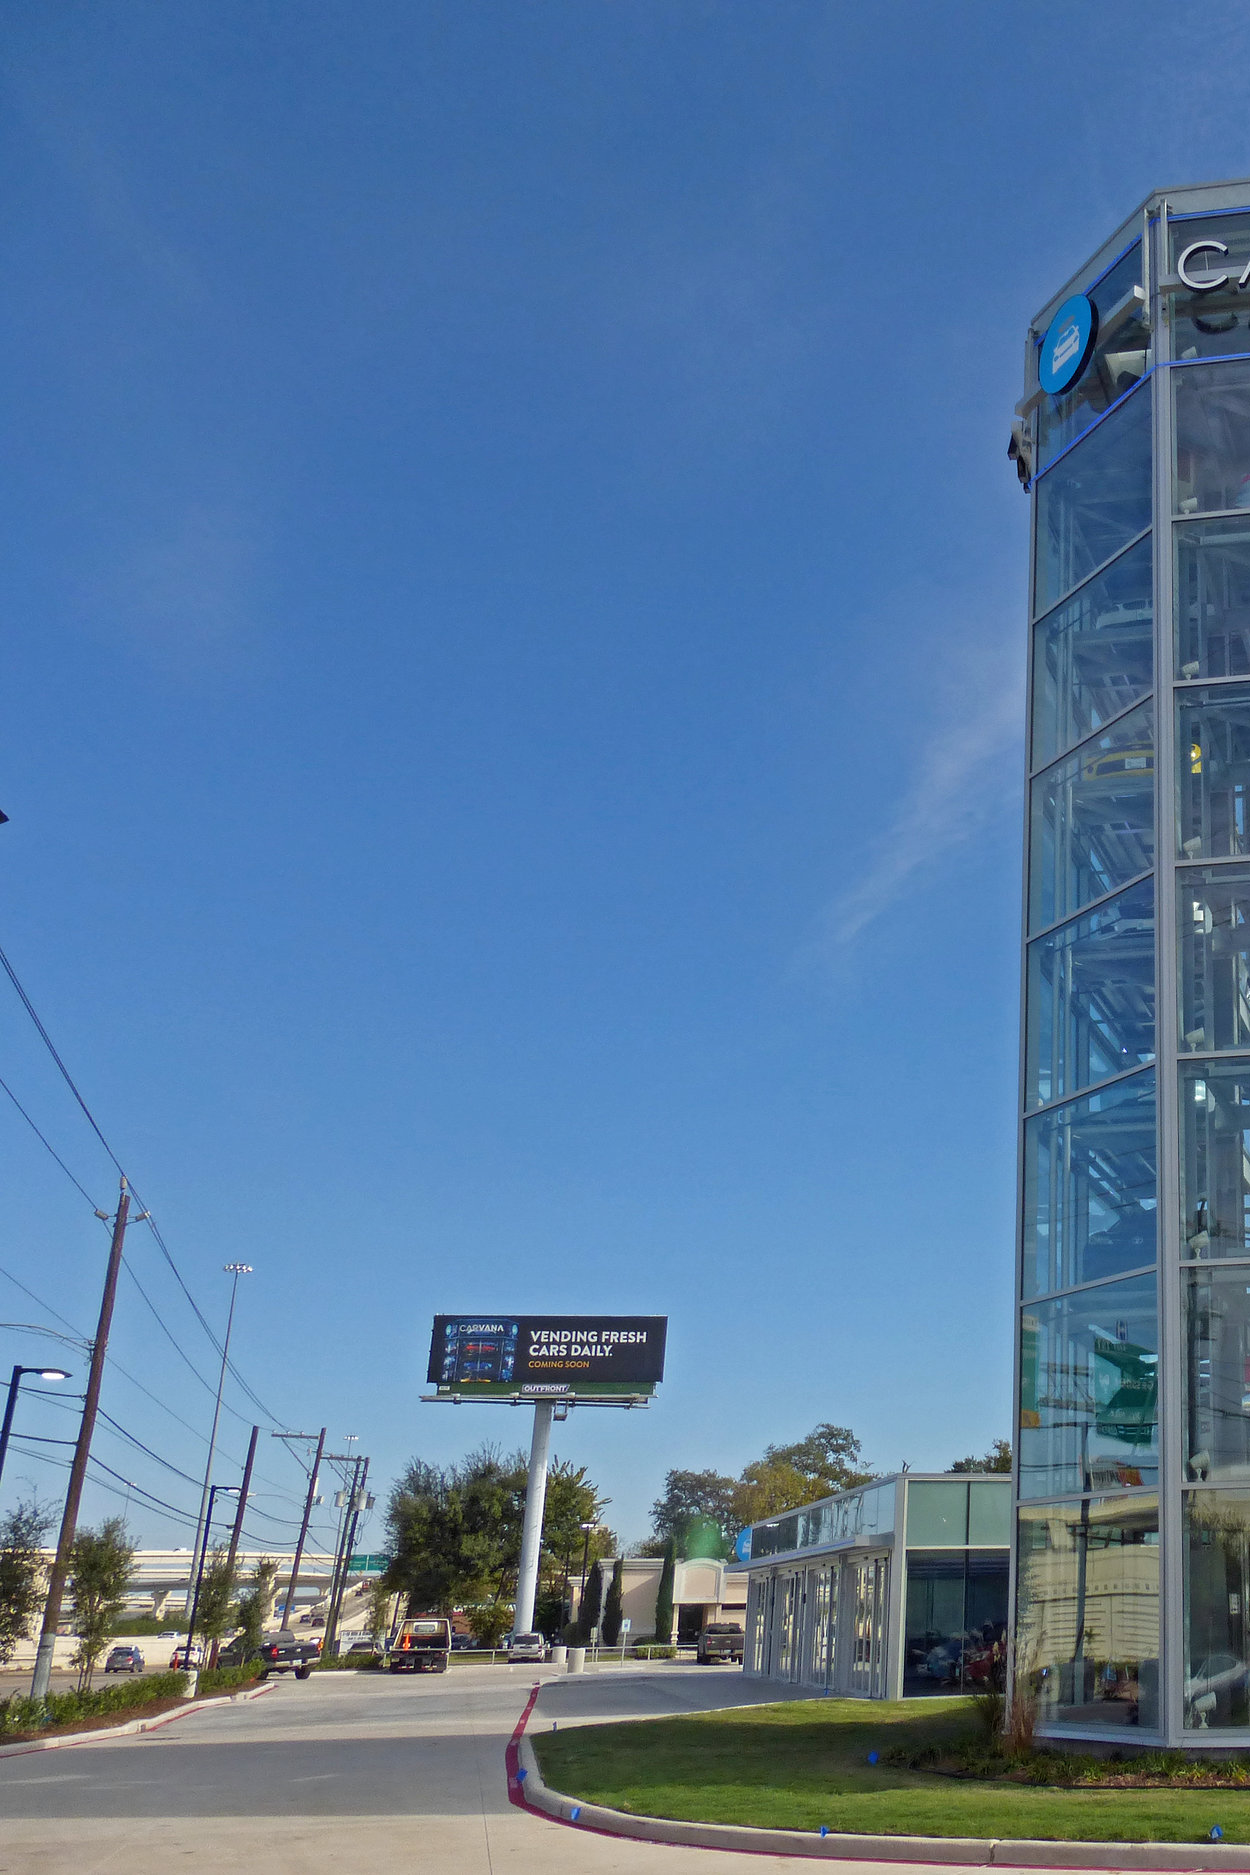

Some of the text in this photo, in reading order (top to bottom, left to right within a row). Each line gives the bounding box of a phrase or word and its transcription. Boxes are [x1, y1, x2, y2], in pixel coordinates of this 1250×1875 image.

[459, 1323, 504, 1332] CARVANA
[530, 1331, 647, 1343] VENDING FRESH
[529, 1345, 613, 1357] CARS DAILY.
[528, 1360, 590, 1369] COMING SOON
[523, 1384, 568, 1393] OUTFRONT
